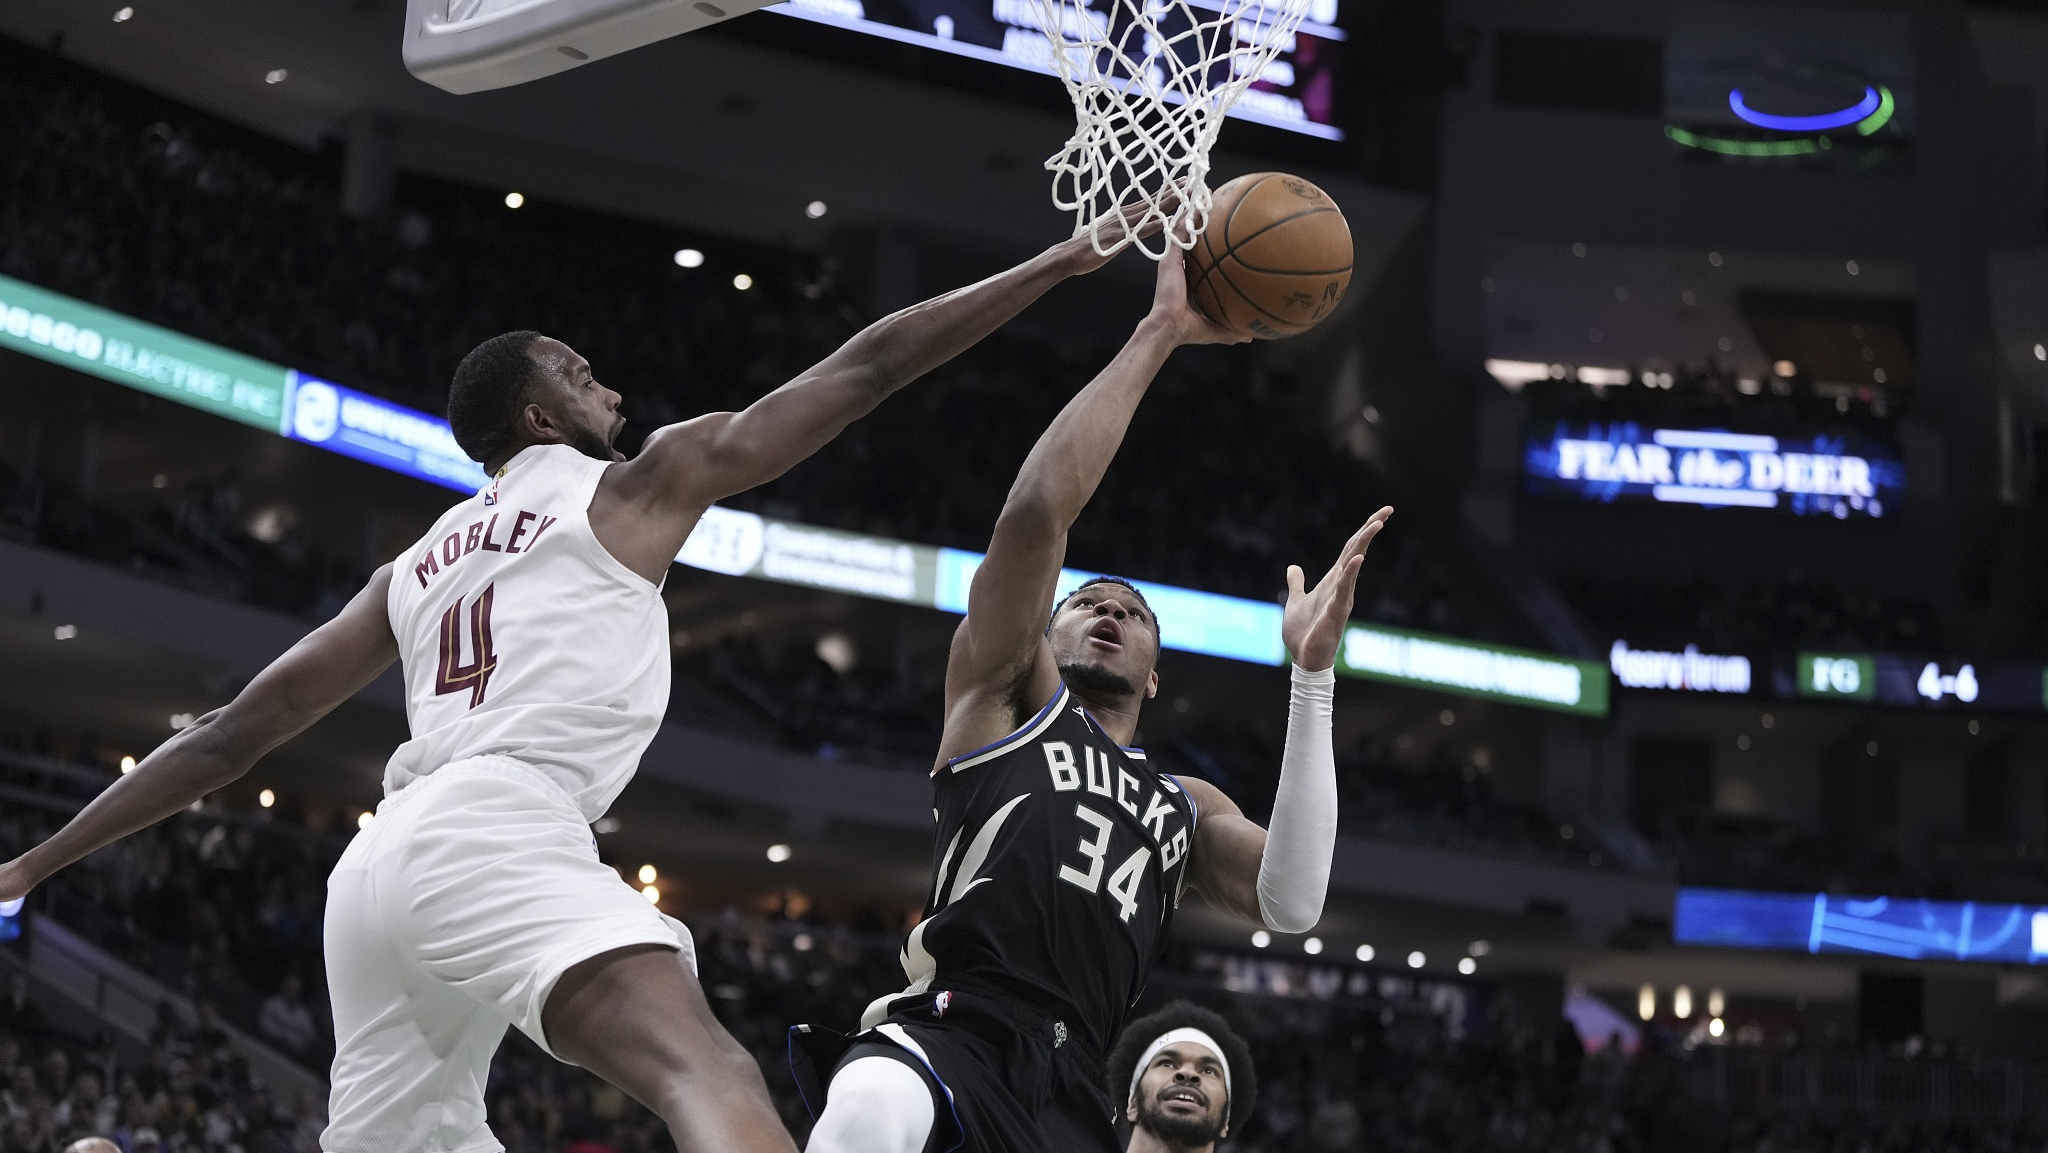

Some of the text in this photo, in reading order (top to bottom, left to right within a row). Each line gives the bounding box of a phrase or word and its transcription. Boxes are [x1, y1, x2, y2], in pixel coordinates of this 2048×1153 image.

[1556, 438, 1874, 498] FEAR the DEER
[415, 510, 557, 590] MOBLEY
[435, 581, 498, 711] 4
[1812, 656, 1979, 702] FG 4-6
[1041, 741, 1188, 873] BUCKS
[1057, 801, 1152, 925] 34
